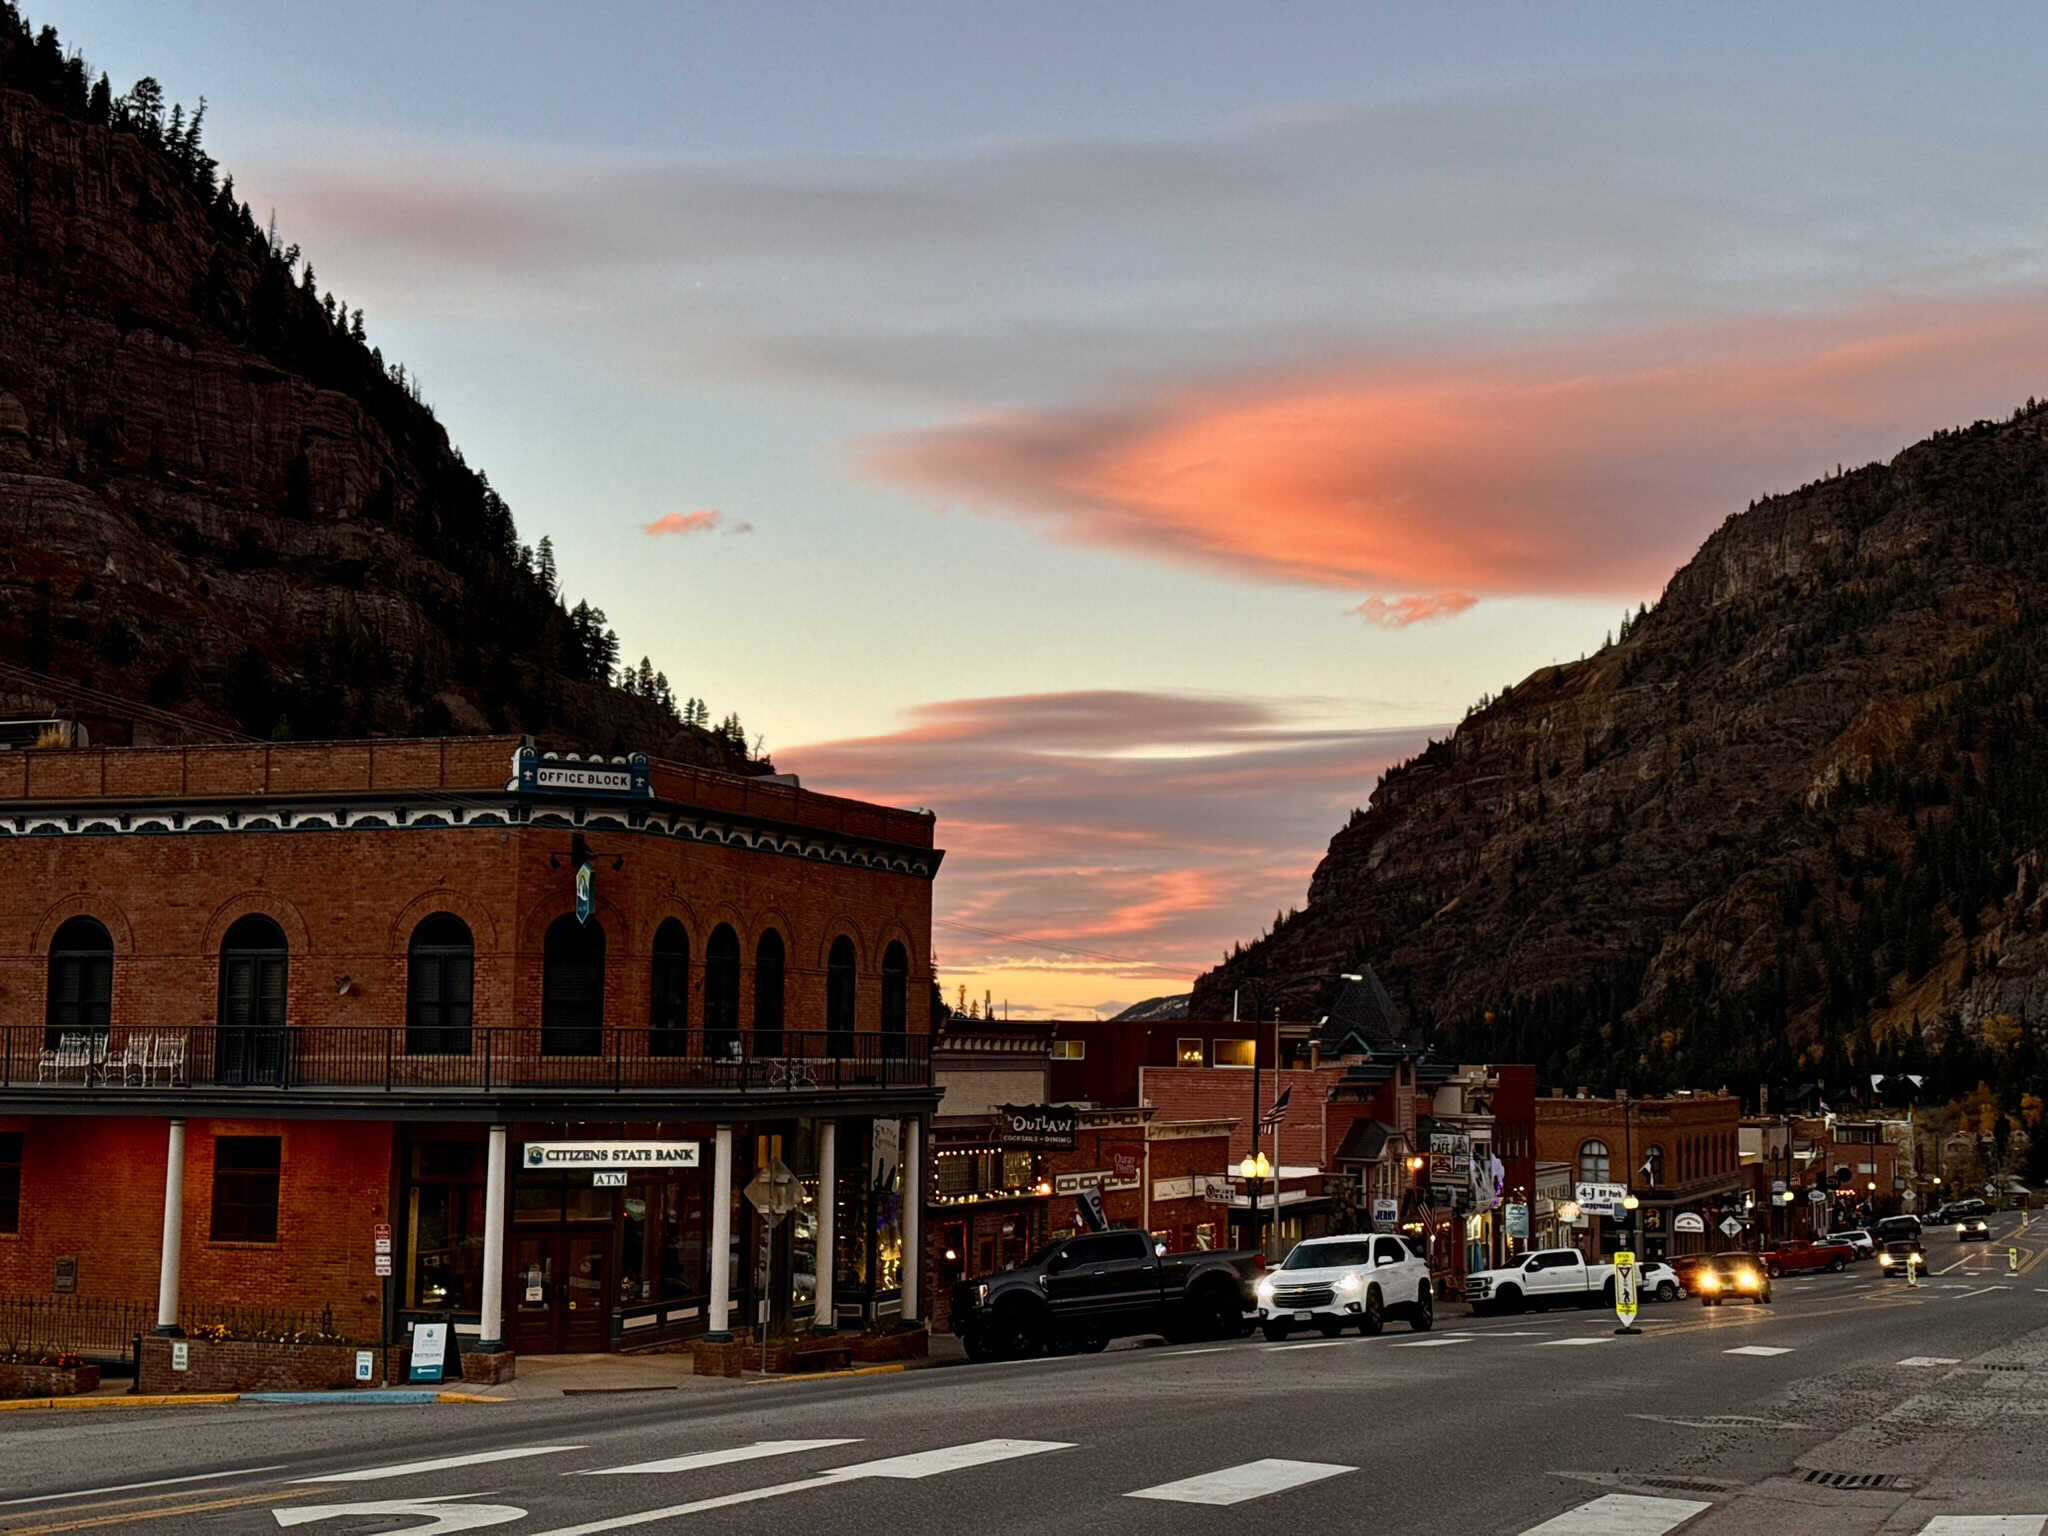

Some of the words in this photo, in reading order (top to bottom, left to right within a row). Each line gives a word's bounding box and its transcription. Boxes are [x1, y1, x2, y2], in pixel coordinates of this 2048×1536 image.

[540, 771, 584, 783] OFFICE
[588, 774, 628, 786] BLOCK
[1003, 1134, 1038, 1143] COCKTAILS
[1045, 1136, 1072, 1144] DINING
[546, 1149, 608, 1161] CITIZENS
[612, 1149, 652, 1161] STATE
[655, 1149, 694, 1161] BANK
[595, 1174, 626, 1185] ATM
[1580, 1187, 1596, 1200] 4-J
[1609, 1189, 1622, 1198] Park
[1375, 1210, 1396, 1220] JERKY
